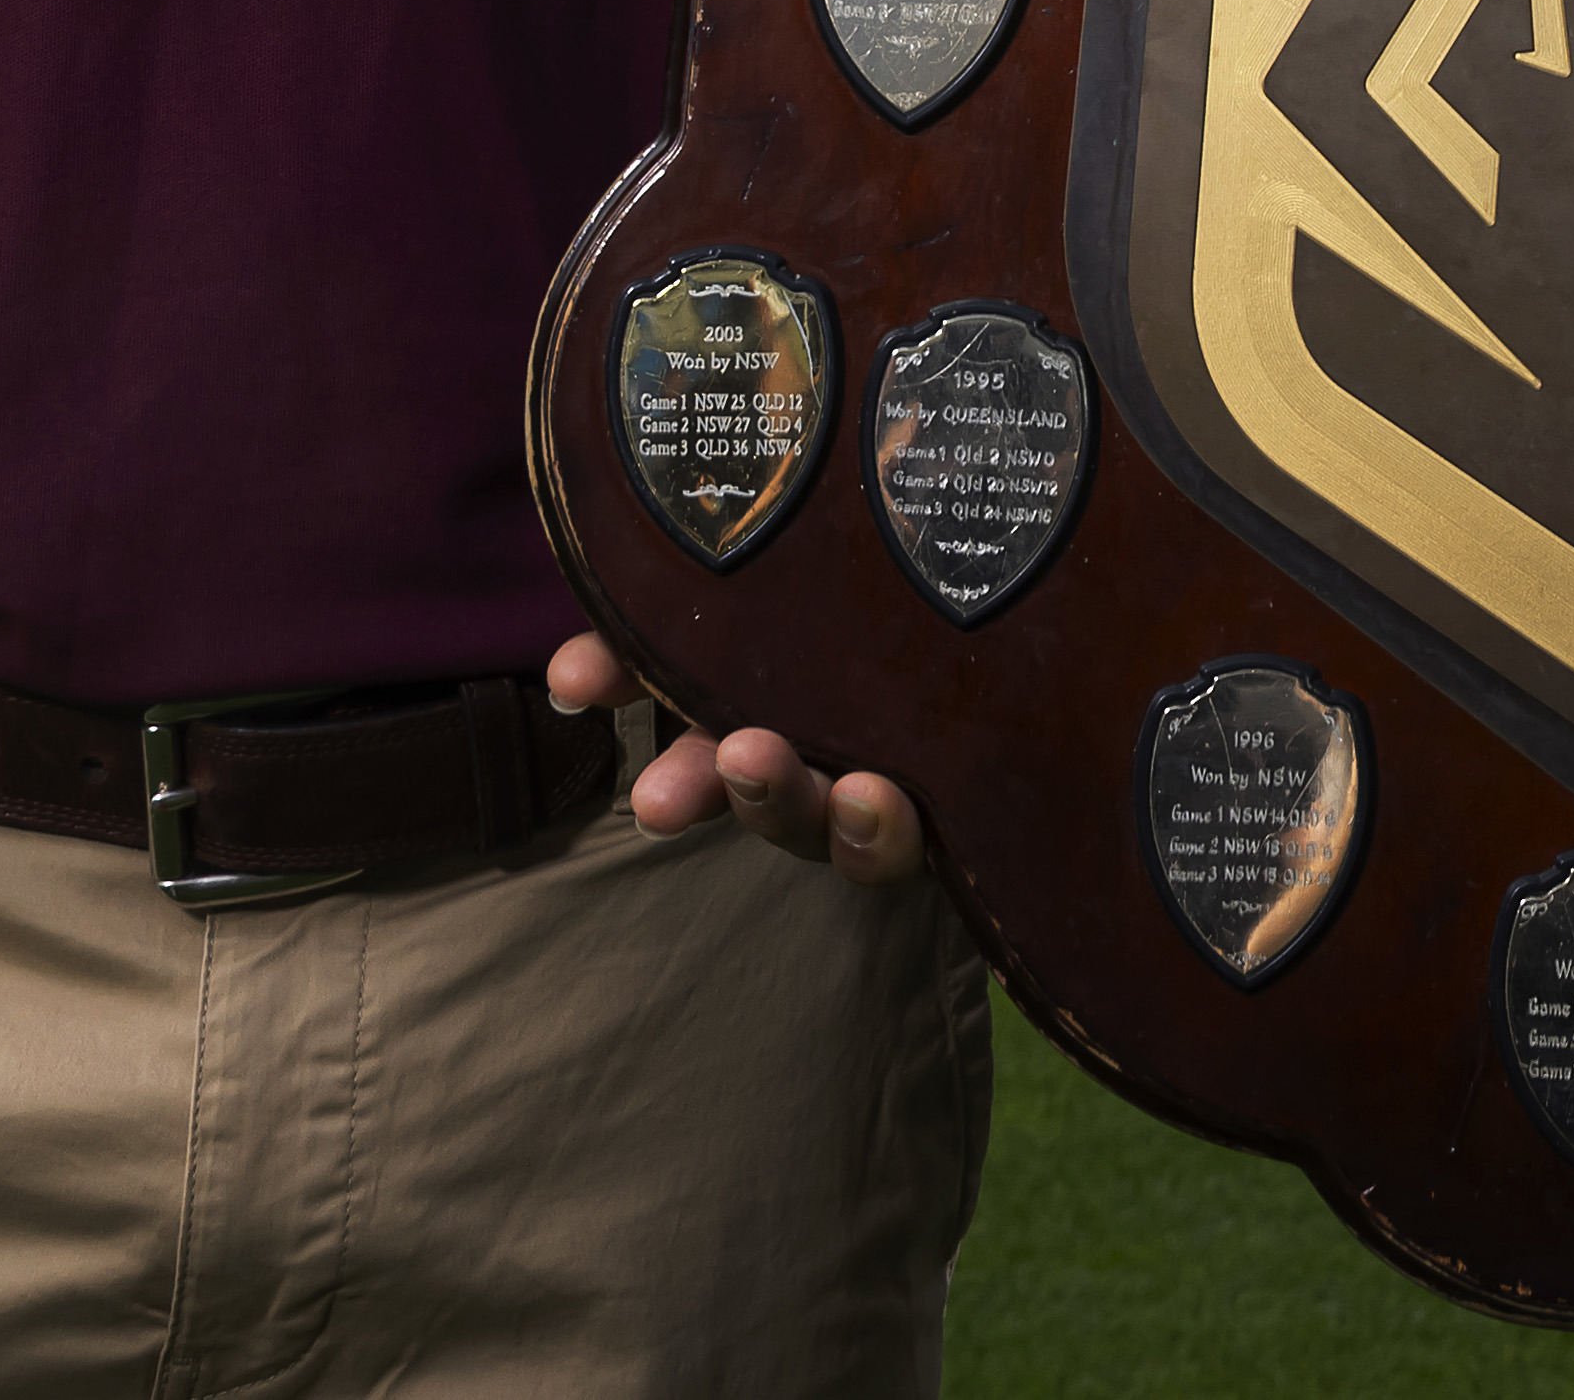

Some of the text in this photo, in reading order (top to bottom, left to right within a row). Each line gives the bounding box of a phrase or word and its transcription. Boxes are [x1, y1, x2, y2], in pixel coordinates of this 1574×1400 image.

[704, 326, 744, 343] 2003
[665, 351, 780, 373] Won by NSW
[954, 371, 1005, 391] 1995
[640, 393, 803, 414] Game 1 NSW 25 QLD 12
[639, 416, 802, 437] Game 2 NSW 27 QLD 4
[918, 403, 1067, 429] by QUEENSLAND
[639, 439, 802, 460] Game 3 QLD 36 NSW 6
[954, 444, 1042, 467] Qld NSW
[954, 473, 1005, 495] Qld 20
[952, 502, 1002, 521] Qld 24
[1234, 731, 1275, 749] 1996
[1191, 765, 1307, 789] Won by NSW
[1172, 803, 1268, 825] Game NSW
[1169, 835, 1260, 856] Game 2 NSW
[1208, 865, 1261, 883] 3 NSW
[1529, 997, 1571, 1017] Game
[1529, 1029, 1568, 1048] Game
[1529, 1059, 1571, 1080] Game
